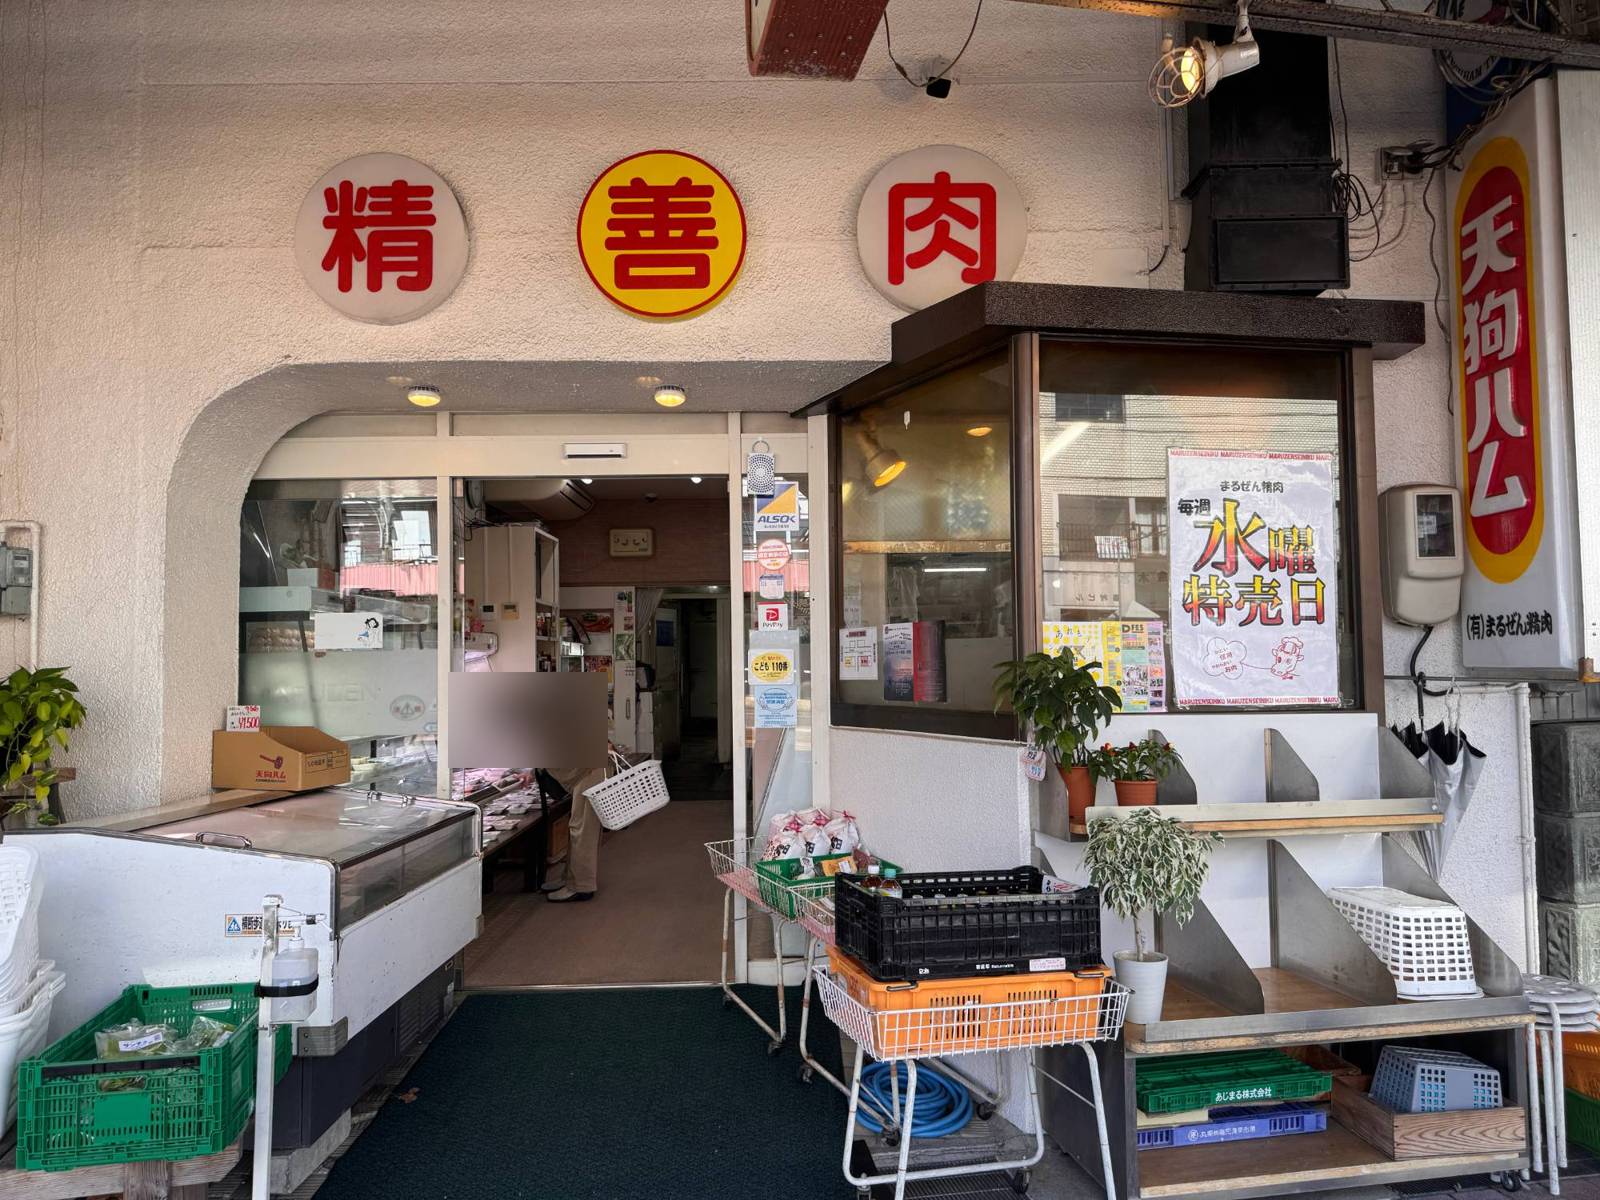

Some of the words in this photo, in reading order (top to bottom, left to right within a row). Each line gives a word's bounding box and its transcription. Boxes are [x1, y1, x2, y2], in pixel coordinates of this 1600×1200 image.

[321, 178, 436, 292] 精
[604, 176, 719, 291] 善
[888, 171, 997, 286] 肉
[1461, 194, 1529, 518] 天狗ハム
[1219, 480, 1284, 493] まるぜん精肉
[757, 515, 796, 524] ALSOK
[1177, 498, 1211, 516] 毎週
[1193, 498, 1318, 577] 水曜
[1182, 574, 1326, 627] 特売日
[1466, 609, 1553, 641] (有)まるぜん精肉
[754, 661, 769, 671] こども
[1215, 1086, 1272, 1103] あじまる株式会社
